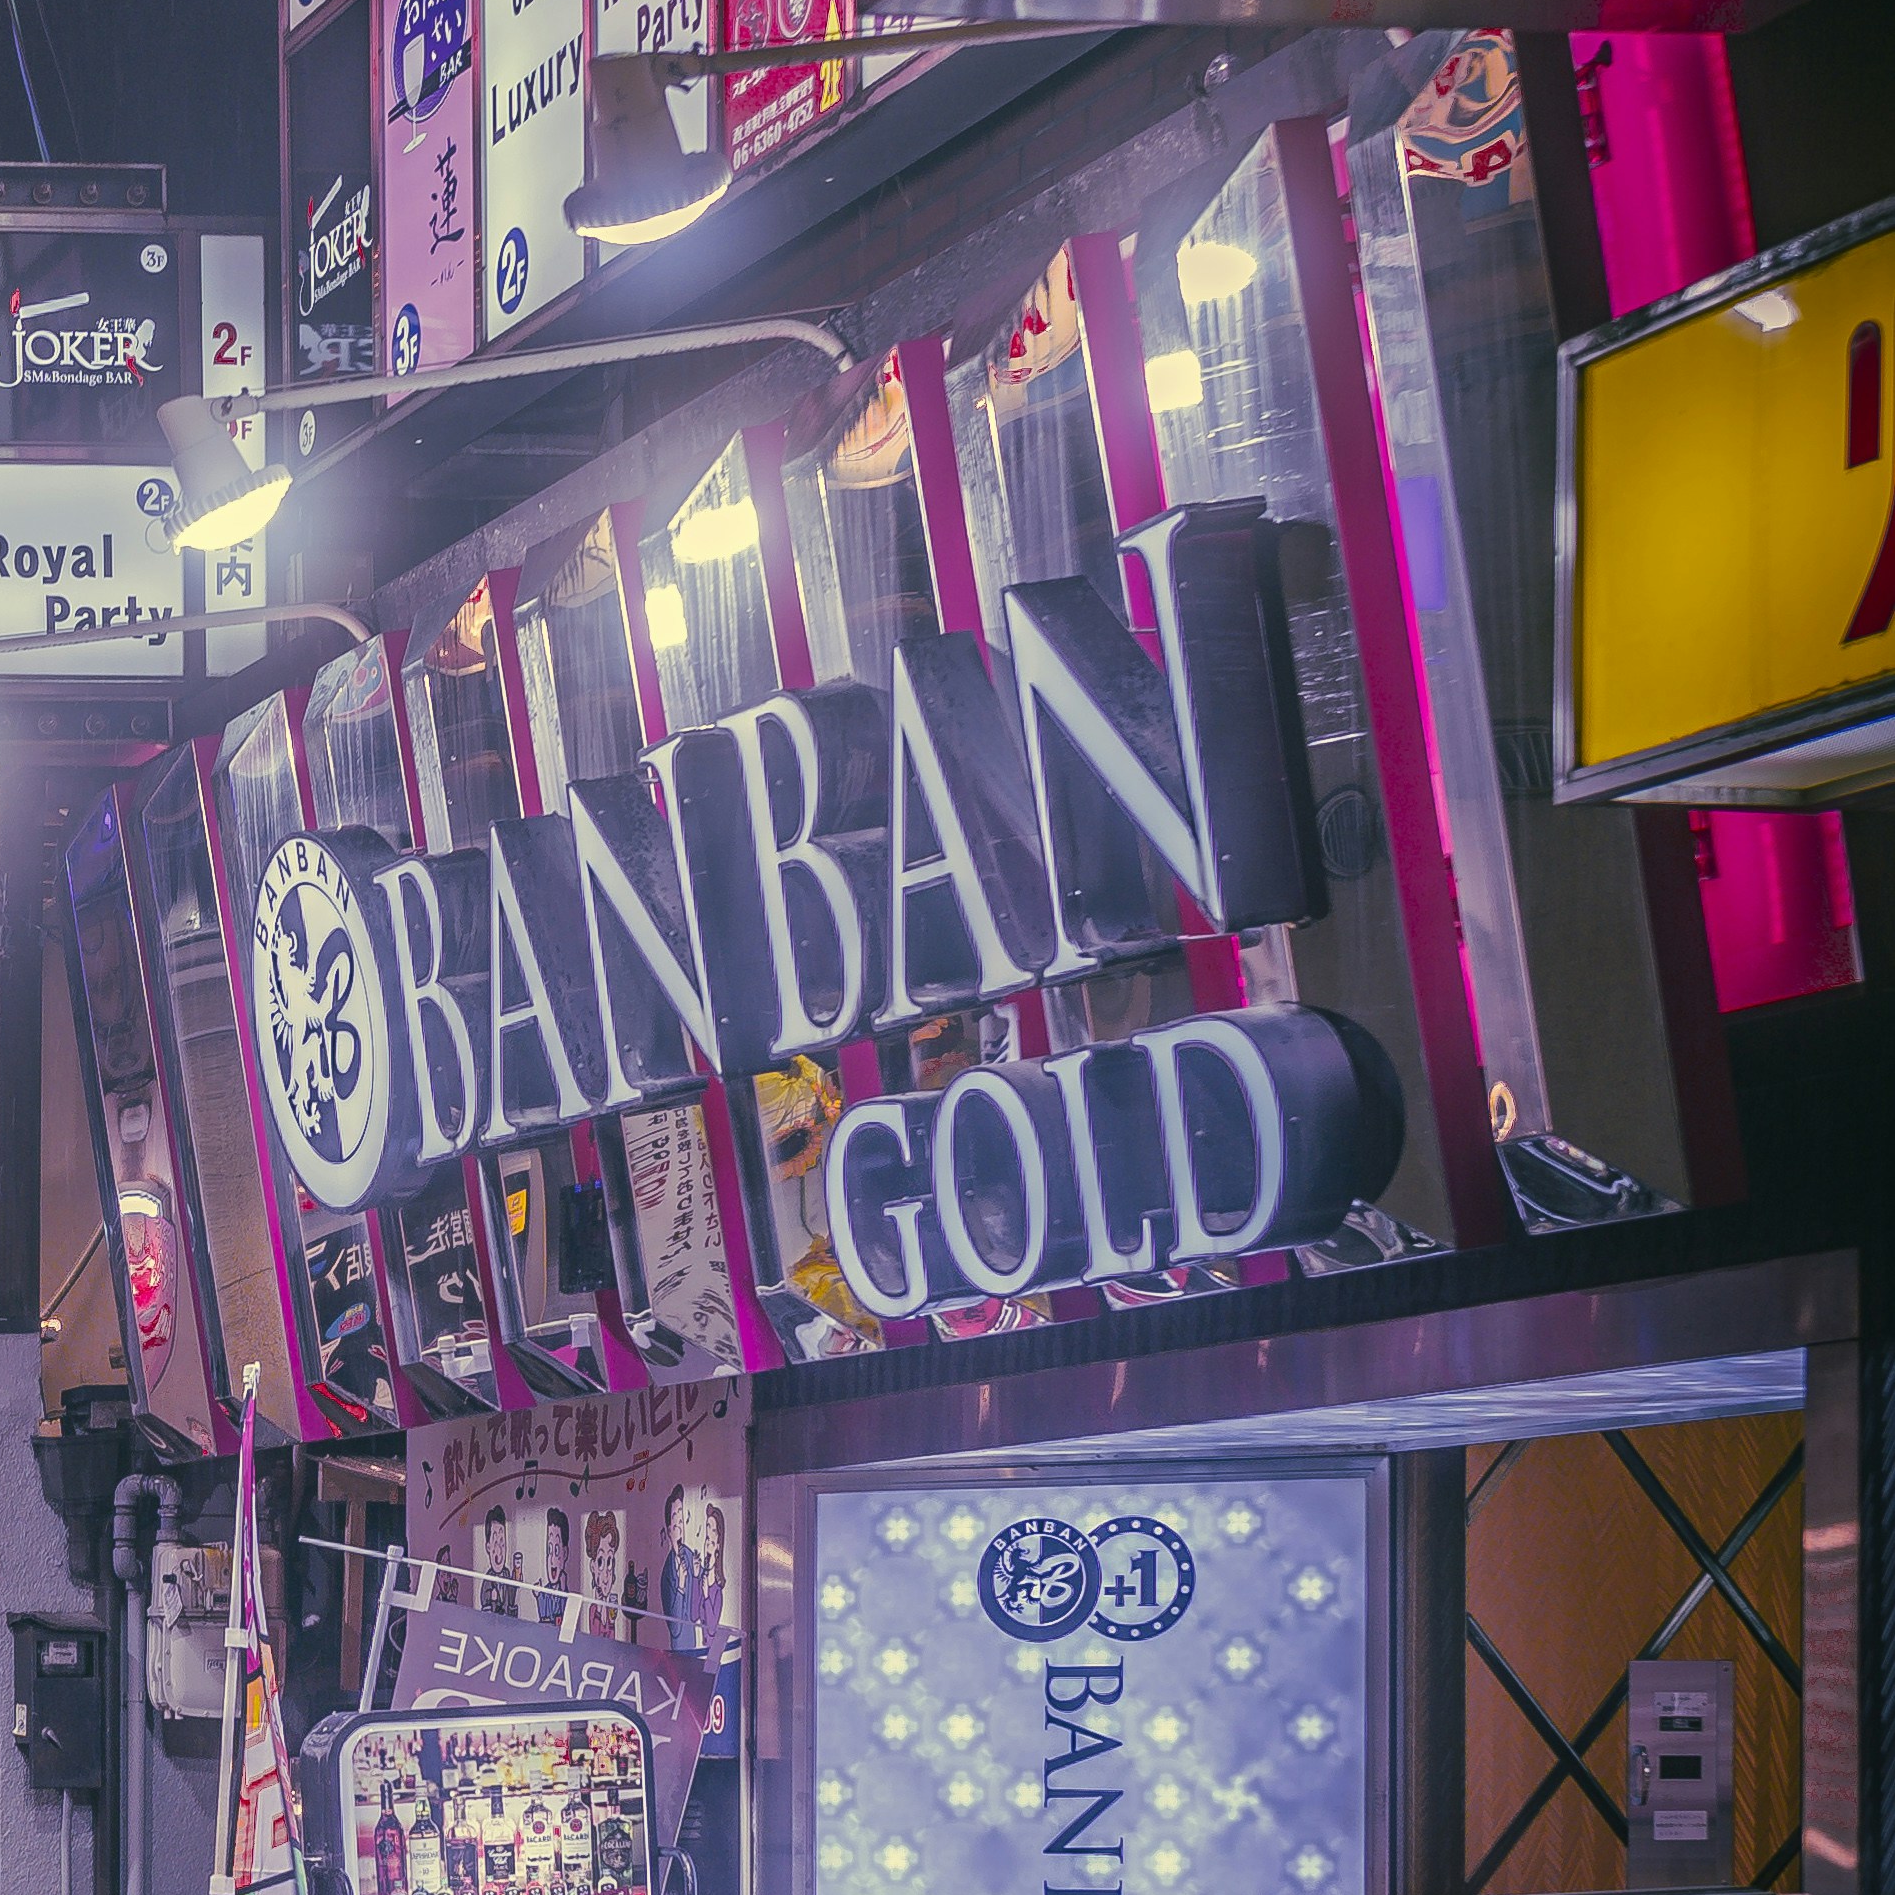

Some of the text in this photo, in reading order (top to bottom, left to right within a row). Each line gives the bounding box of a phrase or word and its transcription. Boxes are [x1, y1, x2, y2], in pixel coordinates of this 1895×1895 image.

[439, 47, 464, 88] BAR
[491, 31, 583, 144] Luxury
[145, 248, 166, 269] 3F
[300, 207, 374, 317] JOKER
[503, 241, 527, 301] 2F
[212, 322, 253, 367] 2F
[24, 371, 134, 386] SM&Bondage BAR
[143, 482, 171, 511] 2F
[47, 595, 174, 645] Party
[253, 836, 356, 946] BANBAN
[825, 1019, 1283, 1320] GOLD
[991, 1520, 1087, 1553] BANBAN
[1105, 1549, 1159, 1608] +1
